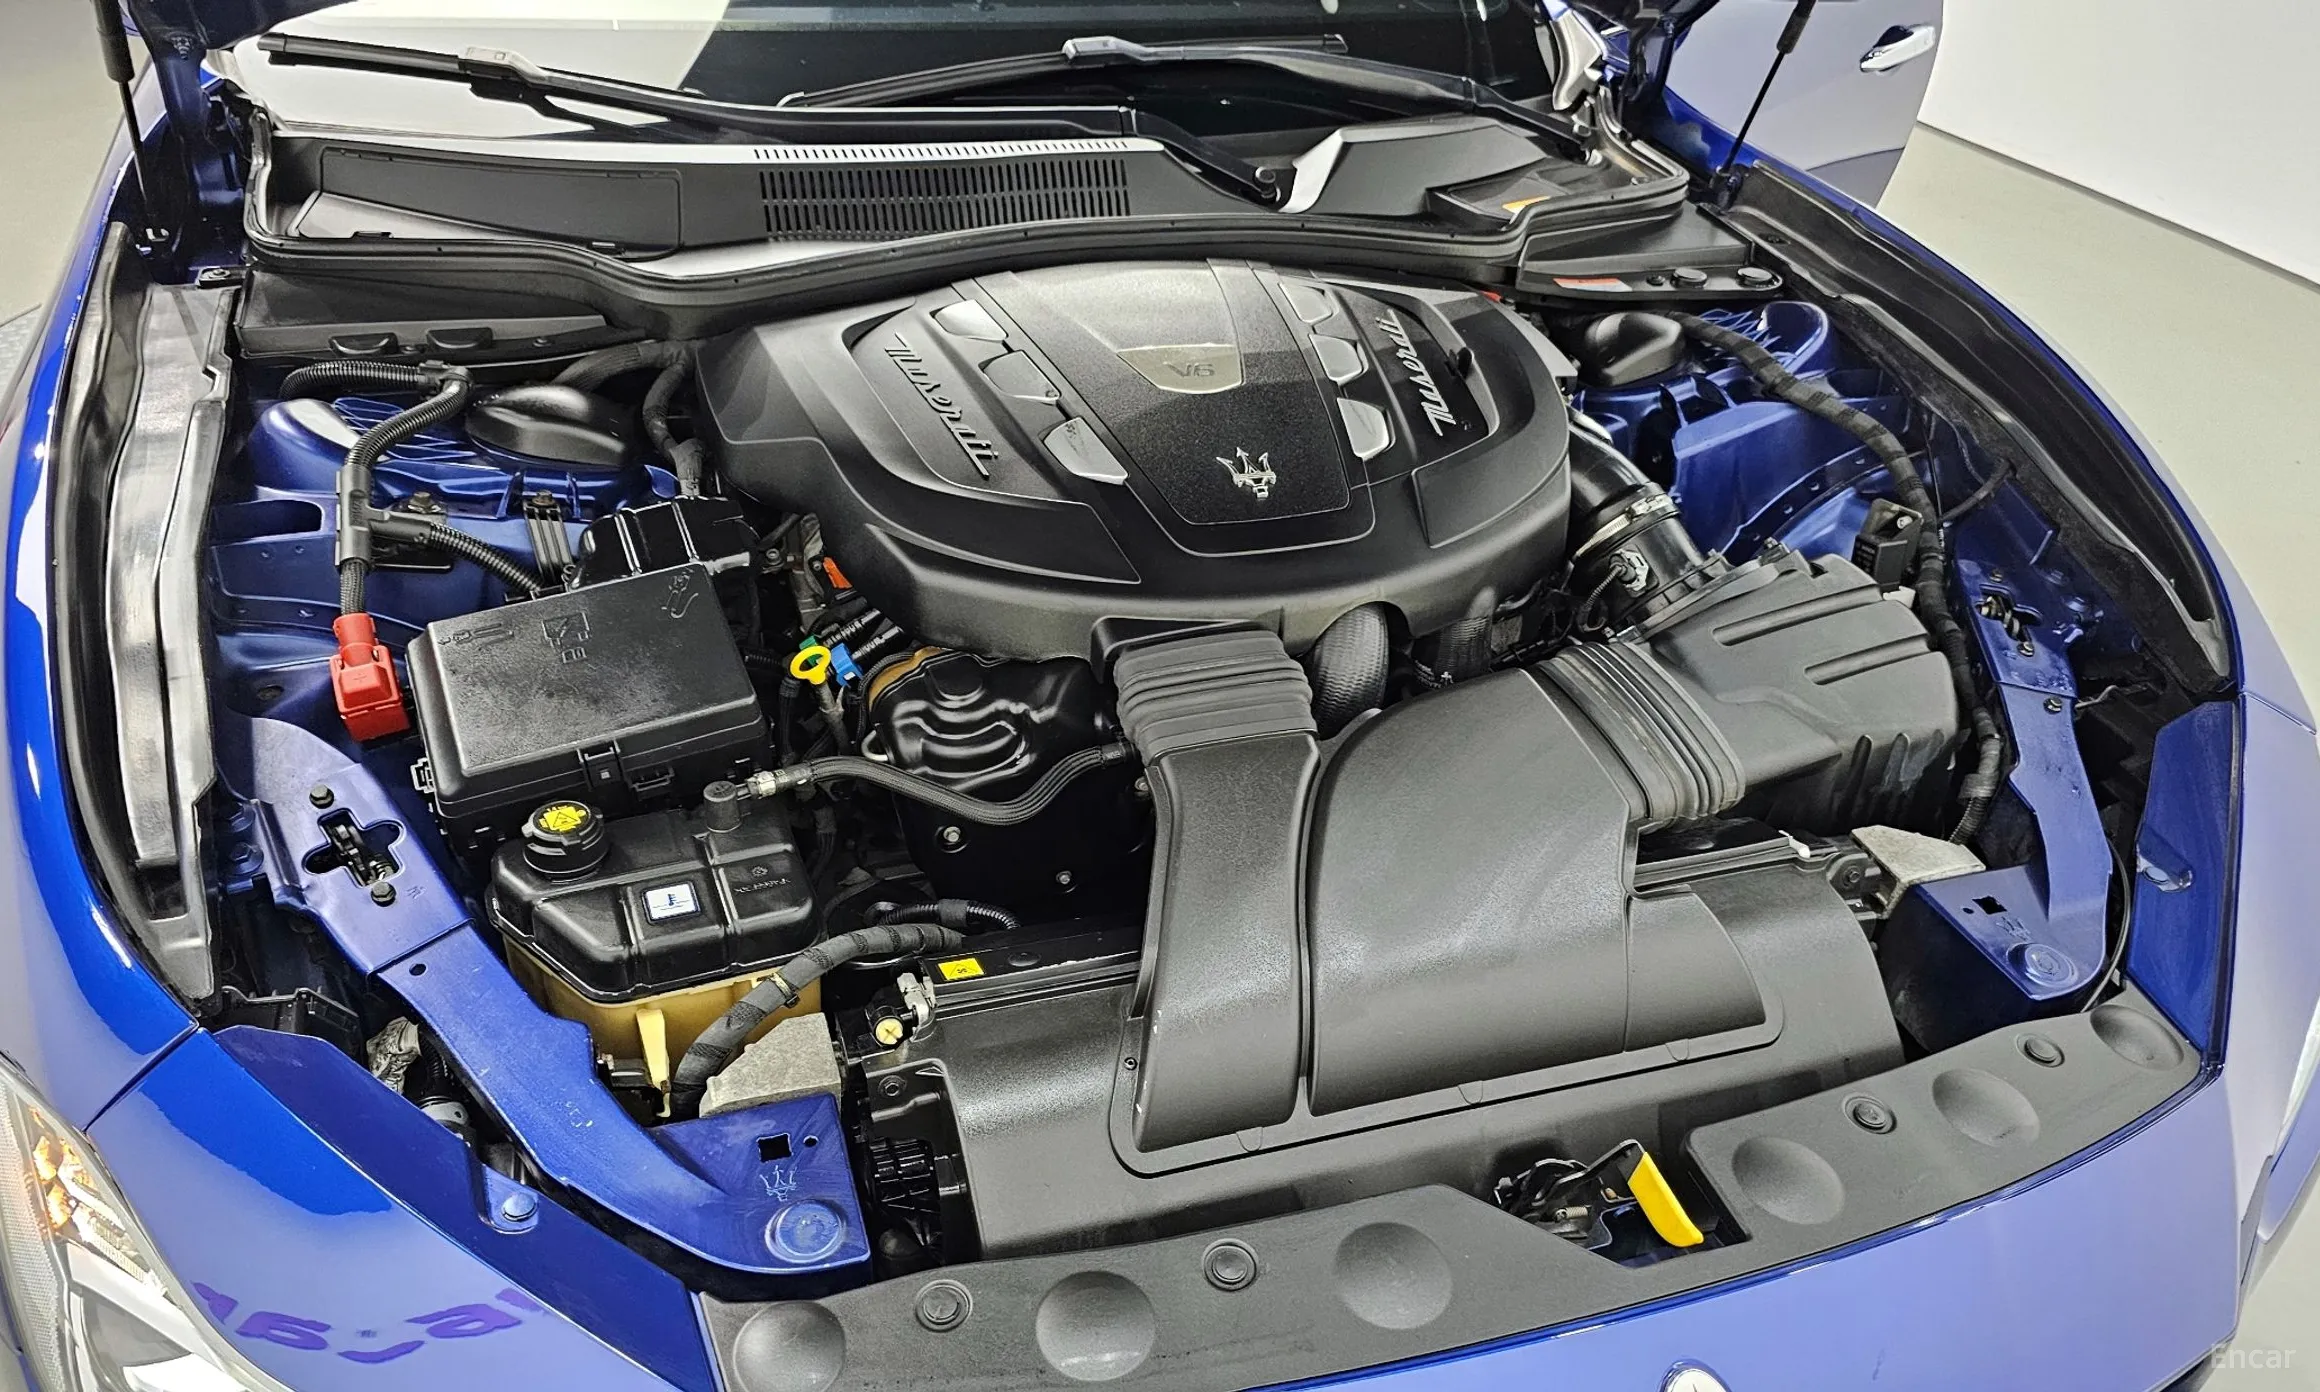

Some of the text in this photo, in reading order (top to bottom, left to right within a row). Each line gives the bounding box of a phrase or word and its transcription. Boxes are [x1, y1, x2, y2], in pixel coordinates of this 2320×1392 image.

[884, 332, 999, 480] Maserati
[1163, 362, 1215, 377] V6
[1375, 308, 1457, 437] Maserati
